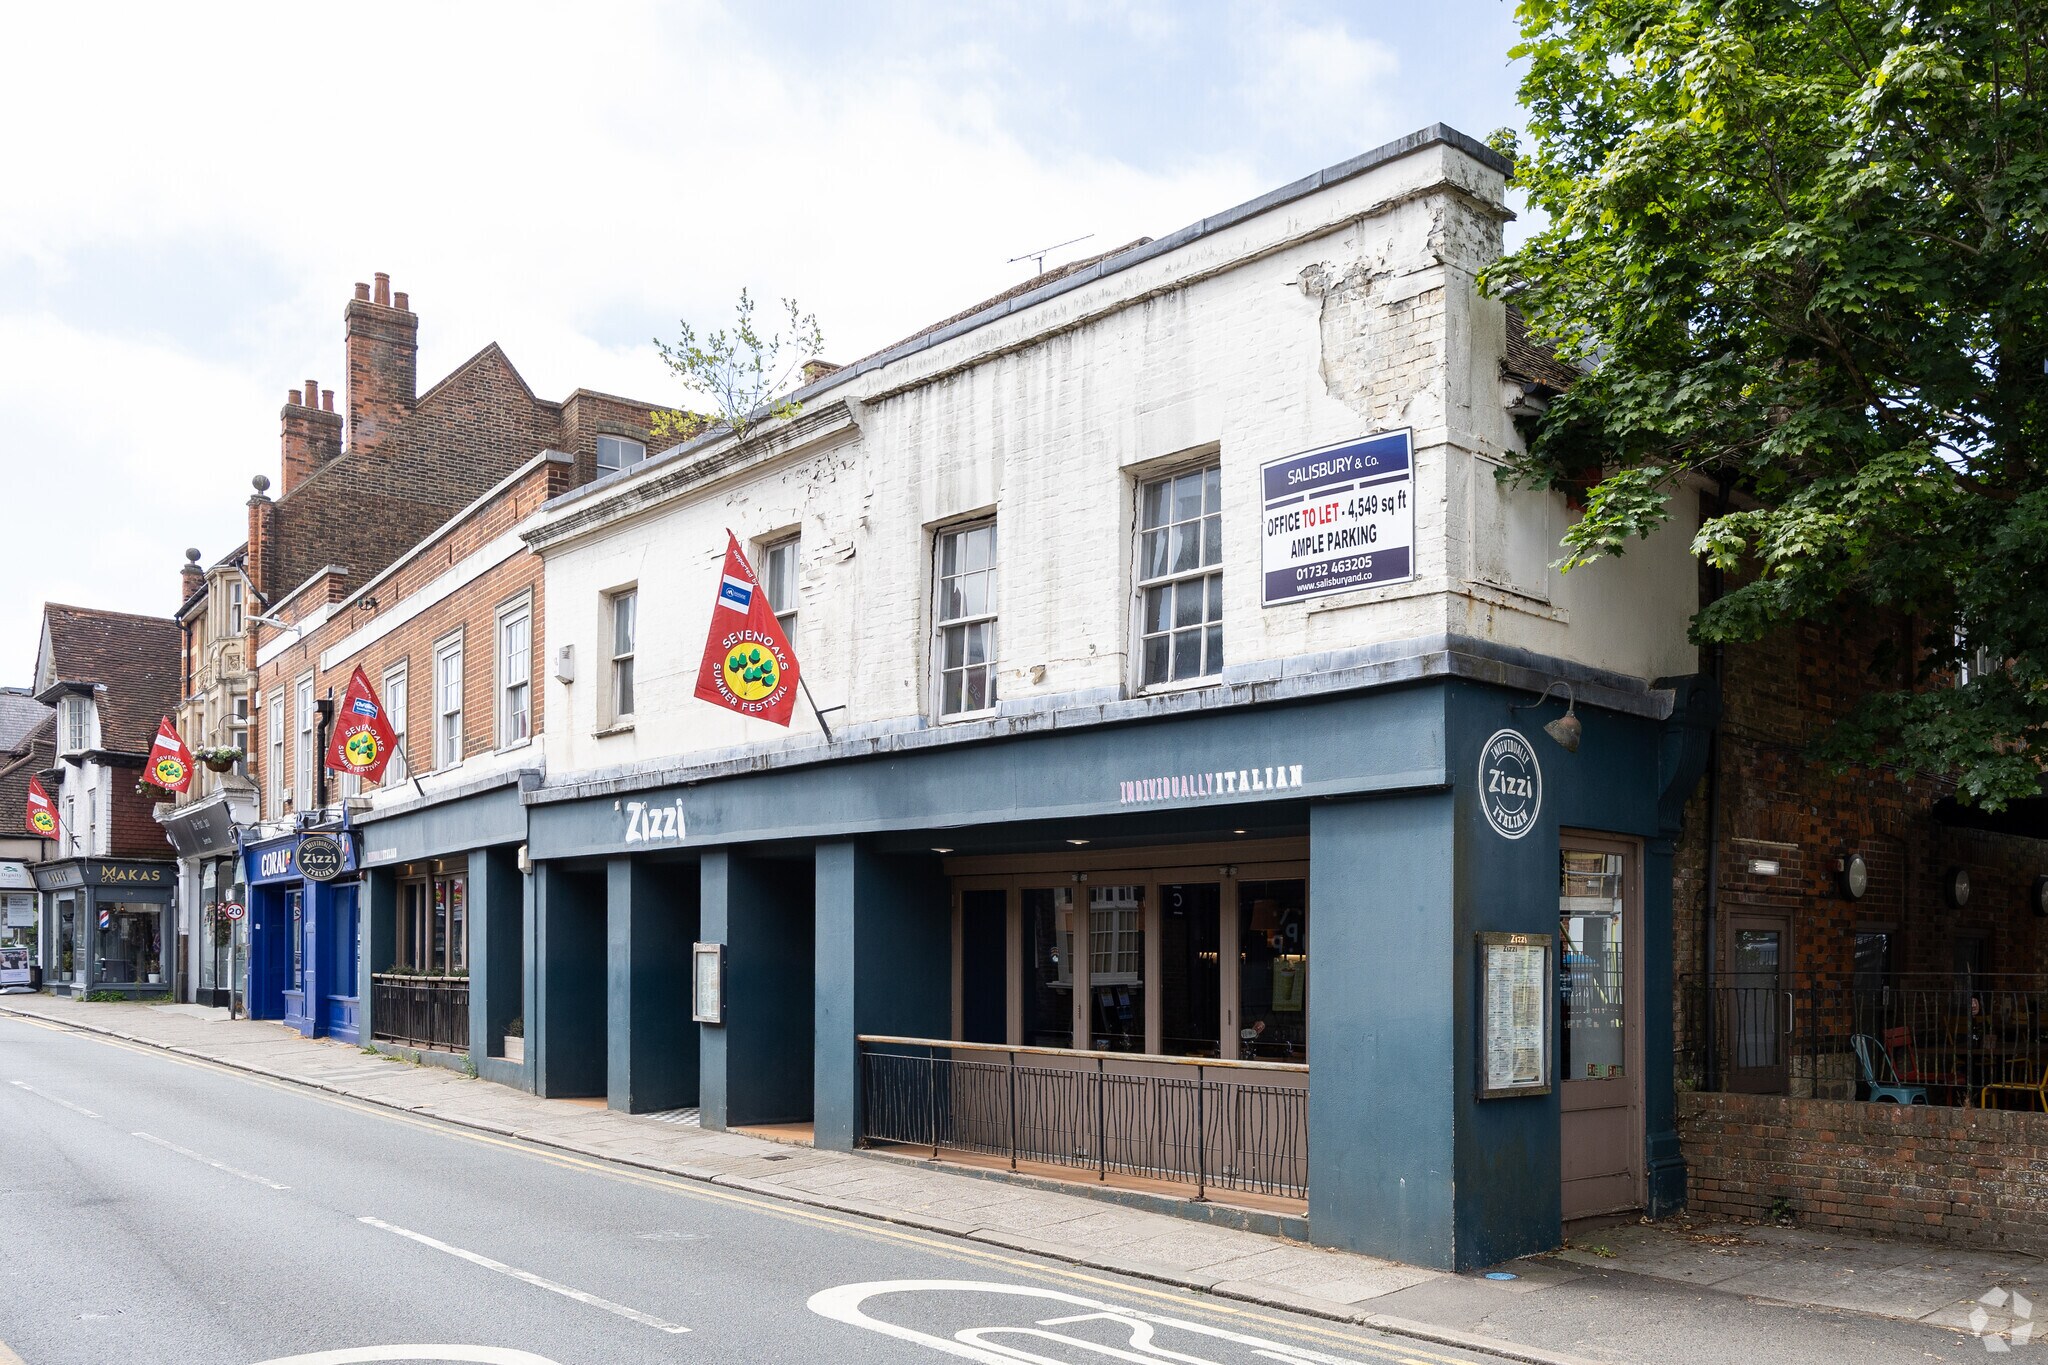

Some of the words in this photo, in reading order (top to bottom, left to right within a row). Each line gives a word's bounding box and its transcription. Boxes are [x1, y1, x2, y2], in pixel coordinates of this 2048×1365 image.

[1288, 456, 1353, 485] SALISBURY
[1354, 458, 1363, 469] &
[1365, 456, 1379, 467] Co.
[1267, 511, 1300, 537] OFFICE
[1302, 508, 1316, 528] TO
[1319, 502, 1339, 525] LET
[1348, 495, 1377, 522] 4,549
[1381, 498, 1395, 515] sq
[1397, 489, 1407, 509] ft
[1291, 535, 1324, 559] AMPLE
[1327, 523, 1377, 551] PARKING
[733, 549, 753, 578] supported
[751, 578, 758, 586] by
[1296, 563, 1328, 580] 01732
[1331, 556, 1372, 574] 463205
[1296, 572, 1373, 592] www.salisburyand.co
[722, 630, 789, 671] SEVENOAKS
[713, 662, 738, 706] SUMMER
[741, 686, 787, 712] FESTIVAL
[345, 724, 384, 752] SEVENOAKS
[156, 755, 188, 773] SEVENOAKS
[338, 745, 352, 771] SUMMER
[353, 760, 380, 772] FESTIVAL
[1490, 739, 1530, 765] INDIVIDUALLY
[1120, 773, 1213, 804] INDIVIDUALLY
[1215, 764, 1303, 795] ITALIAN
[1488, 768, 1532, 799] Zizzi
[625, 798, 686, 845] Zizzi
[1493, 805, 1529, 828] ITALIAN
[302, 853, 337, 864] Zizzi
[304, 840, 334, 851] INDIVIDUALLY
[101, 864, 161, 883] MAKAS
[261, 849, 287, 877] CORAL
[306, 867, 335, 877] ITALIAN
[229, 907, 241, 916] 20
[1511, 934, 1527, 944] Zizzi
